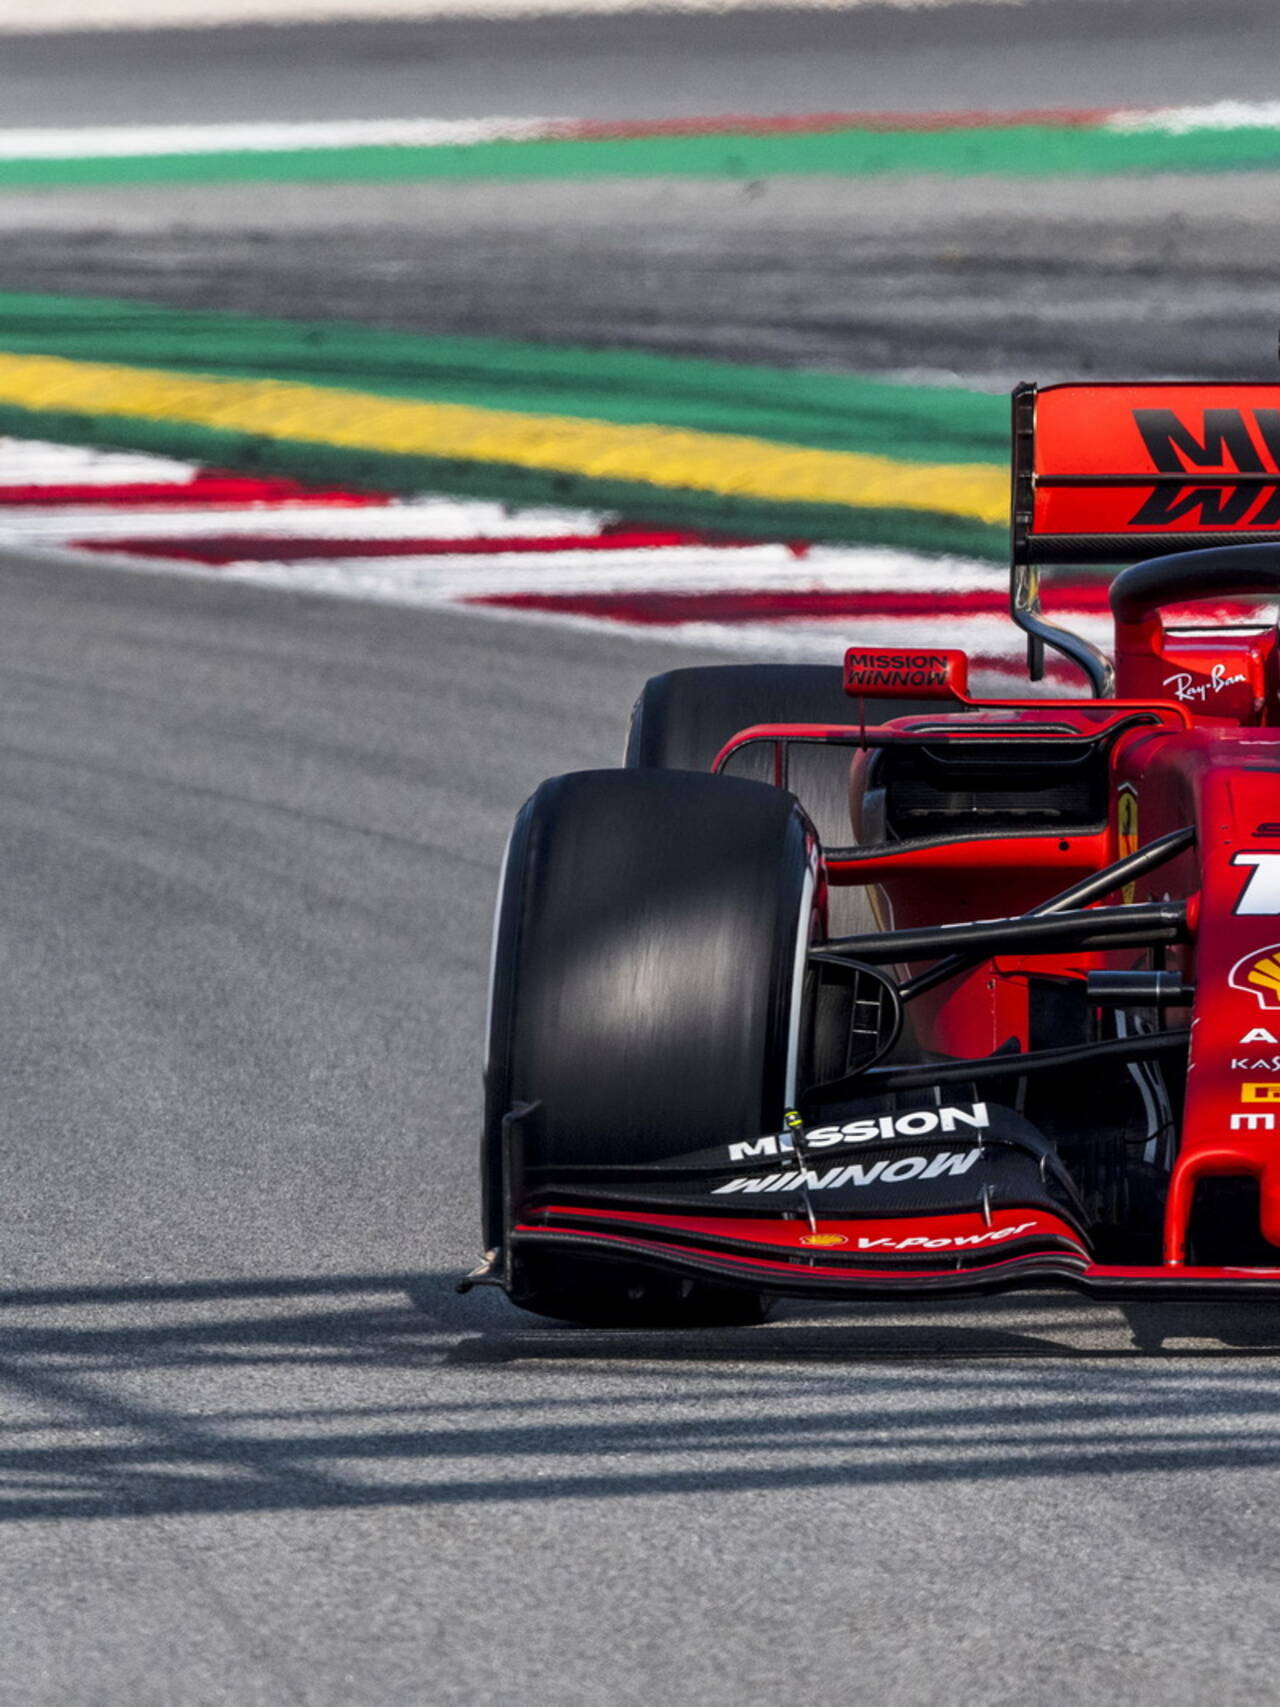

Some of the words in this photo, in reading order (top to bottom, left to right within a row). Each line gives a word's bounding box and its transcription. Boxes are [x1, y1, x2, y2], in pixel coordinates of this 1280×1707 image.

[849, 654, 947, 669] MISSION
[847, 669, 947, 686] WINNOW
[1163, 664, 1247, 701] Ray-Ban
[711, 1147, 985, 1194] WINNOW
[858, 1221, 1037, 1249] V-Power
